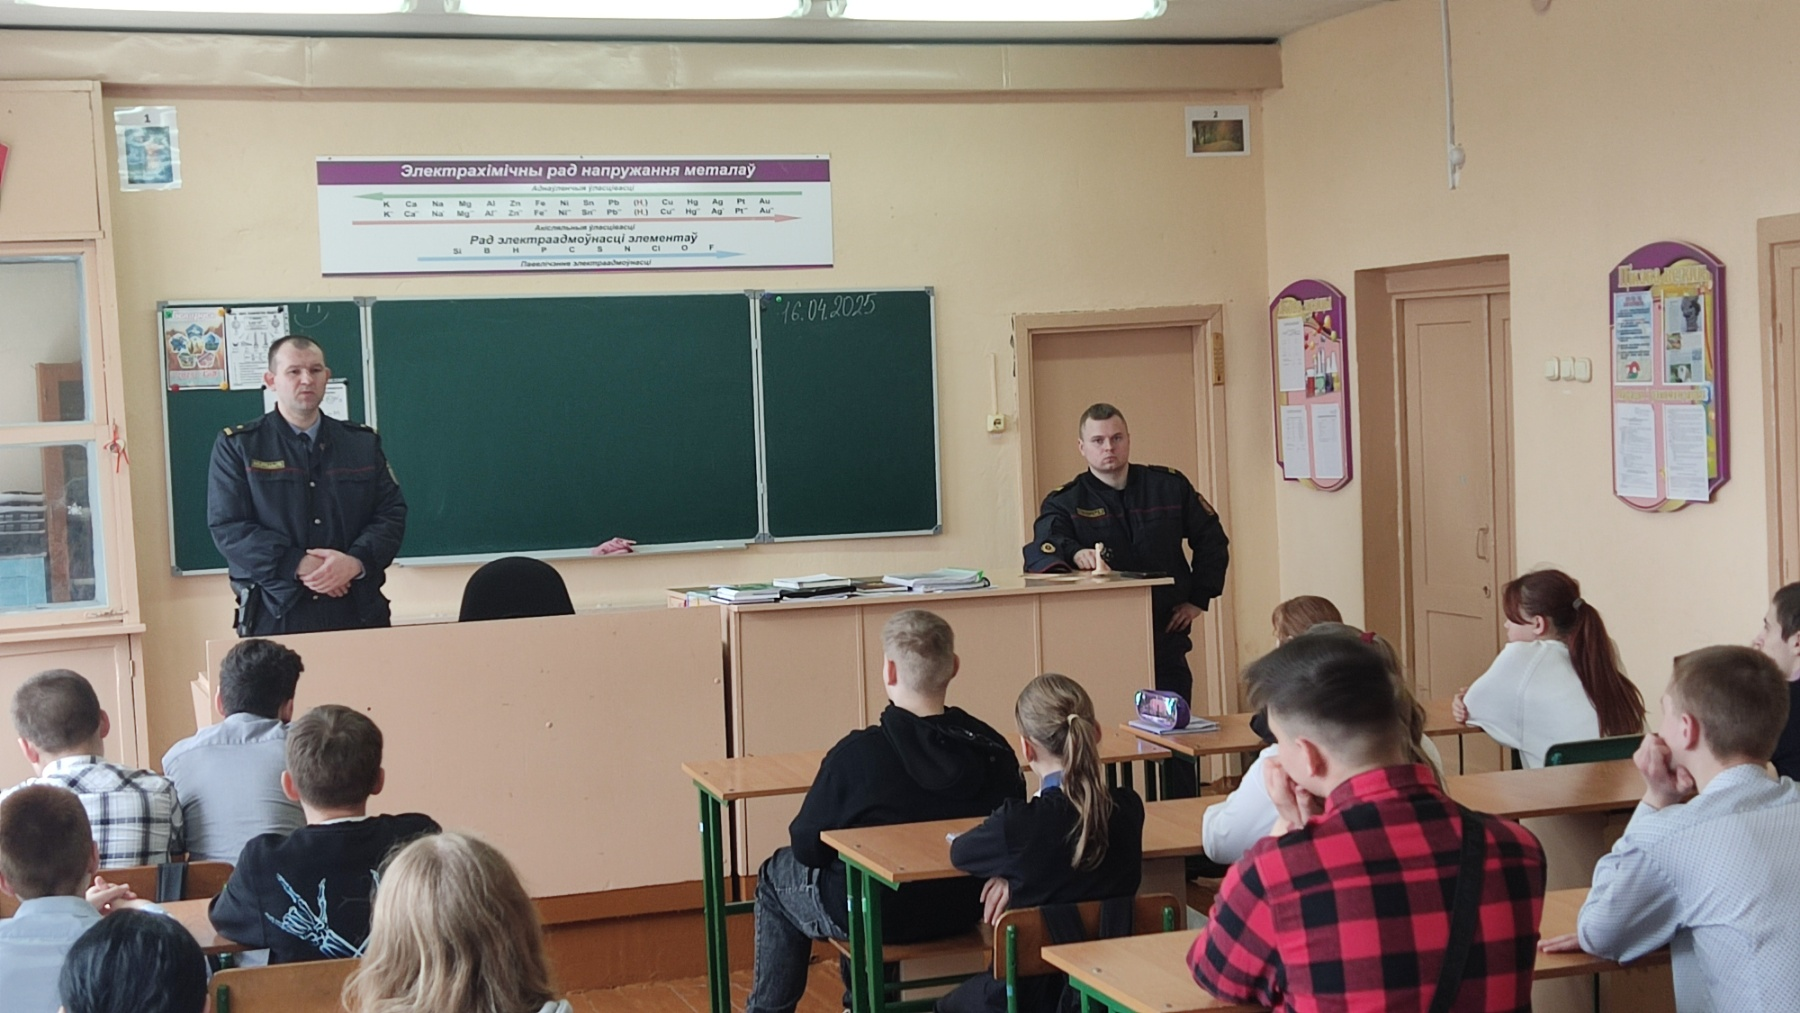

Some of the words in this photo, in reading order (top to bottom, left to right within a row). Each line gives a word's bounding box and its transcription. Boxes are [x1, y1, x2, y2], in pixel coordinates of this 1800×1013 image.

[144, 113, 151, 123] 1
[1213, 110, 1219, 118] 2
[400, 164, 543, 180] Электрахімічны
[546, 164, 578, 180] рад
[581, 165, 680, 180] напружання
[684, 163, 756, 179] металаў
[459, 200, 472, 208] Mg
[686, 198, 699, 206] Hg
[712, 198, 724, 206] Ag
[759, 197, 771, 205] Au
[469, 235, 494, 245] Рад
[497, 233, 626, 246] электраадмоўнасці
[628, 231, 698, 245] элементаў
[781, 293, 877, 324] 16.04.2025
